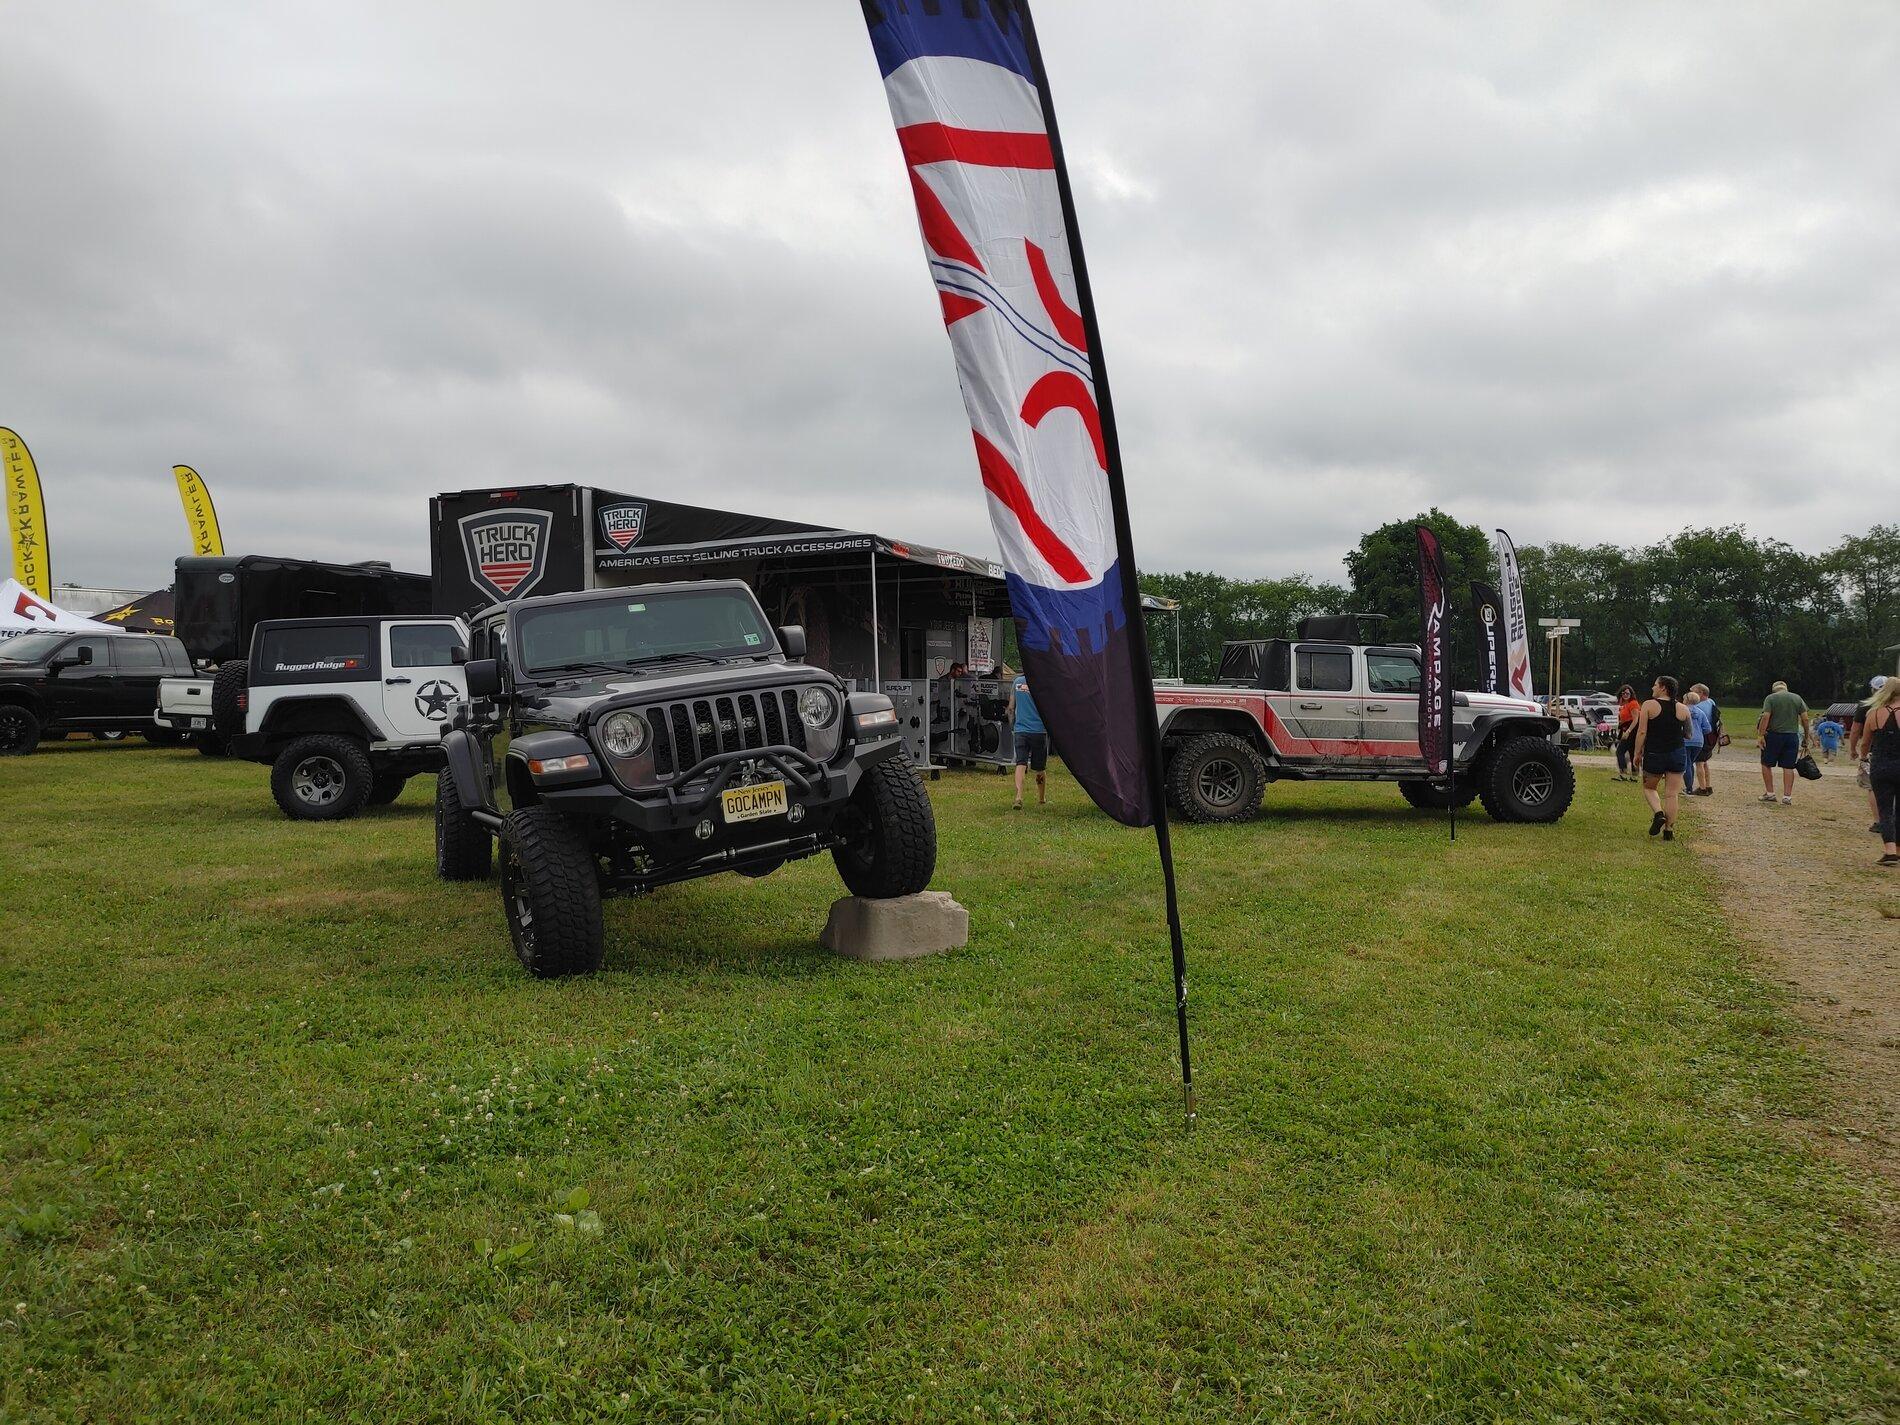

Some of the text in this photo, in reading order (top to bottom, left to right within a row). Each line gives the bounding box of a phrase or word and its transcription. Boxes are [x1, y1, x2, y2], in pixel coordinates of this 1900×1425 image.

[605, 510, 640, 521] TRUCK
[608, 519, 638, 530] HERO
[474, 525, 537, 545] TRUCK
[480, 542, 533, 563] HERO
[599, 539, 872, 568] AMERICA'S BEST SELLING TRUCK ACCESSORIES
[1427, 587, 1446, 728] RAMPAGE
[1483, 606, 1497, 694] SUPERL
[275, 661, 345, 672] Rugged Ridge
[737, 786, 769, 796] New Jersey
[727, 790, 782, 814] GOCAMPN
